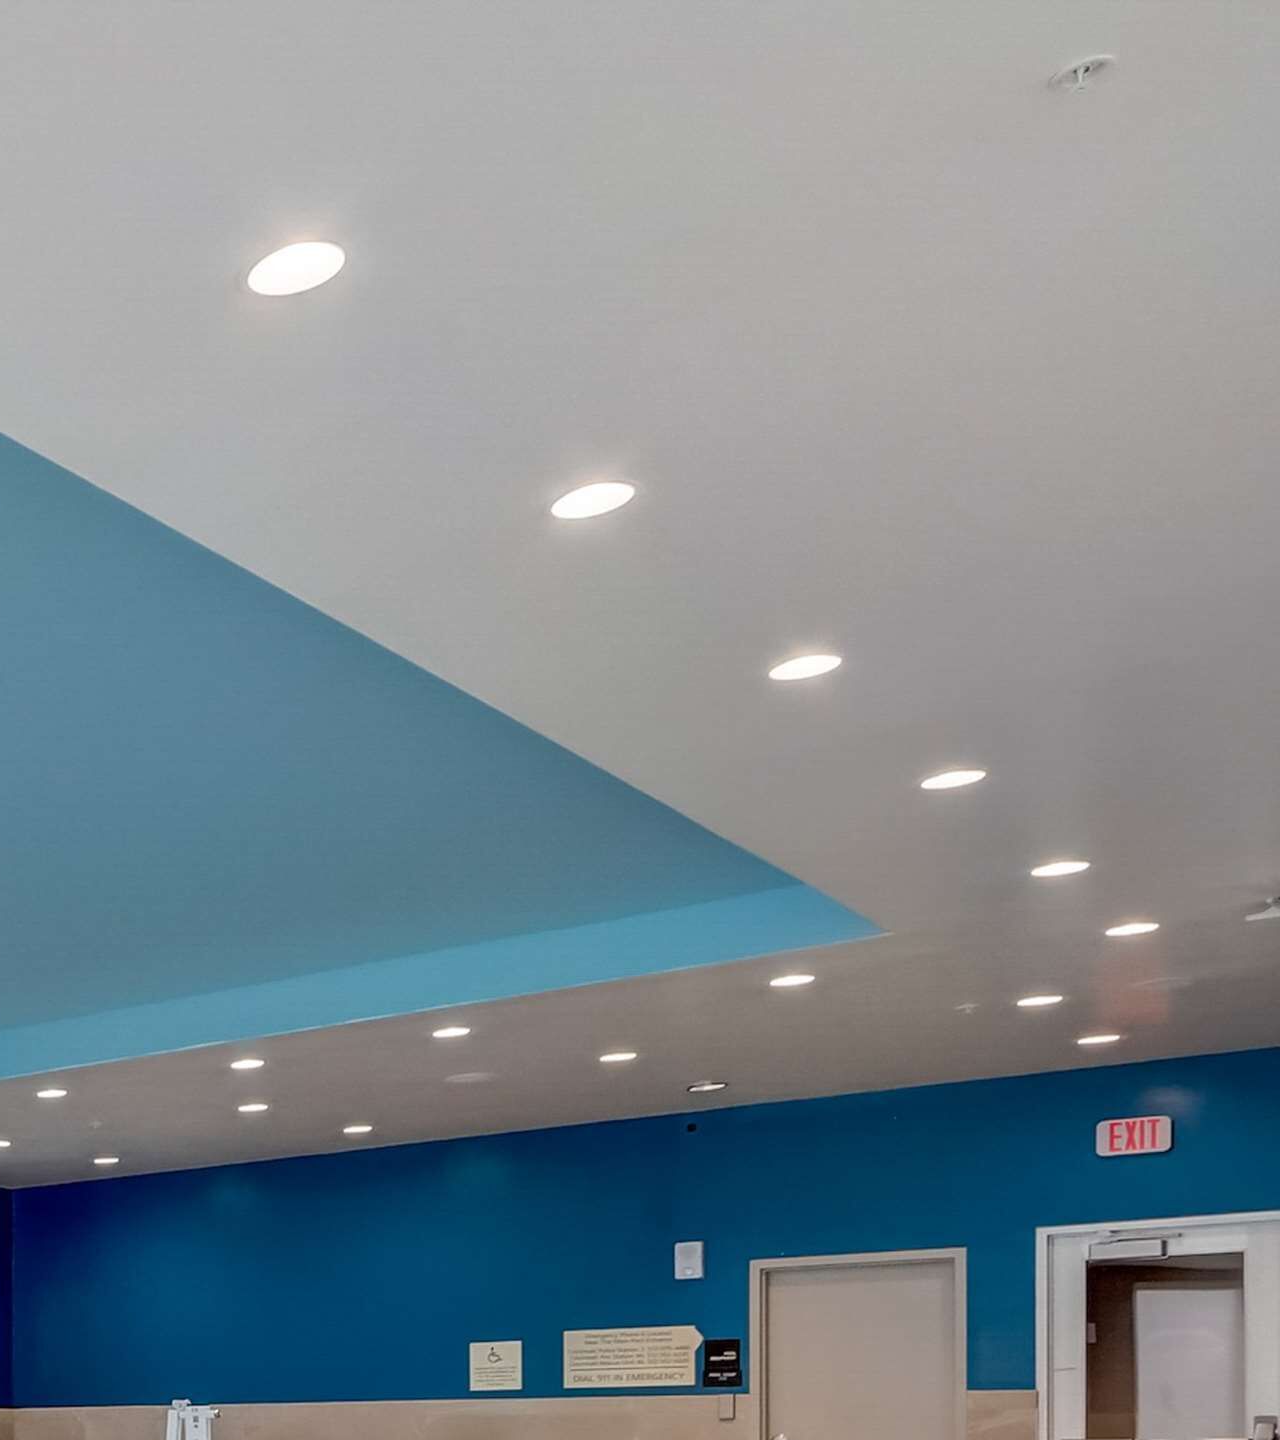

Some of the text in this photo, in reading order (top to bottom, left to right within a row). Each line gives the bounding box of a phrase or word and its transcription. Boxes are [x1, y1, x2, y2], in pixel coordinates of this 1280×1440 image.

[1109, 1119, 1161, 1153] EXIT
[572, 1373, 685, 1383] DIAL 911 IN EMERGENCY
